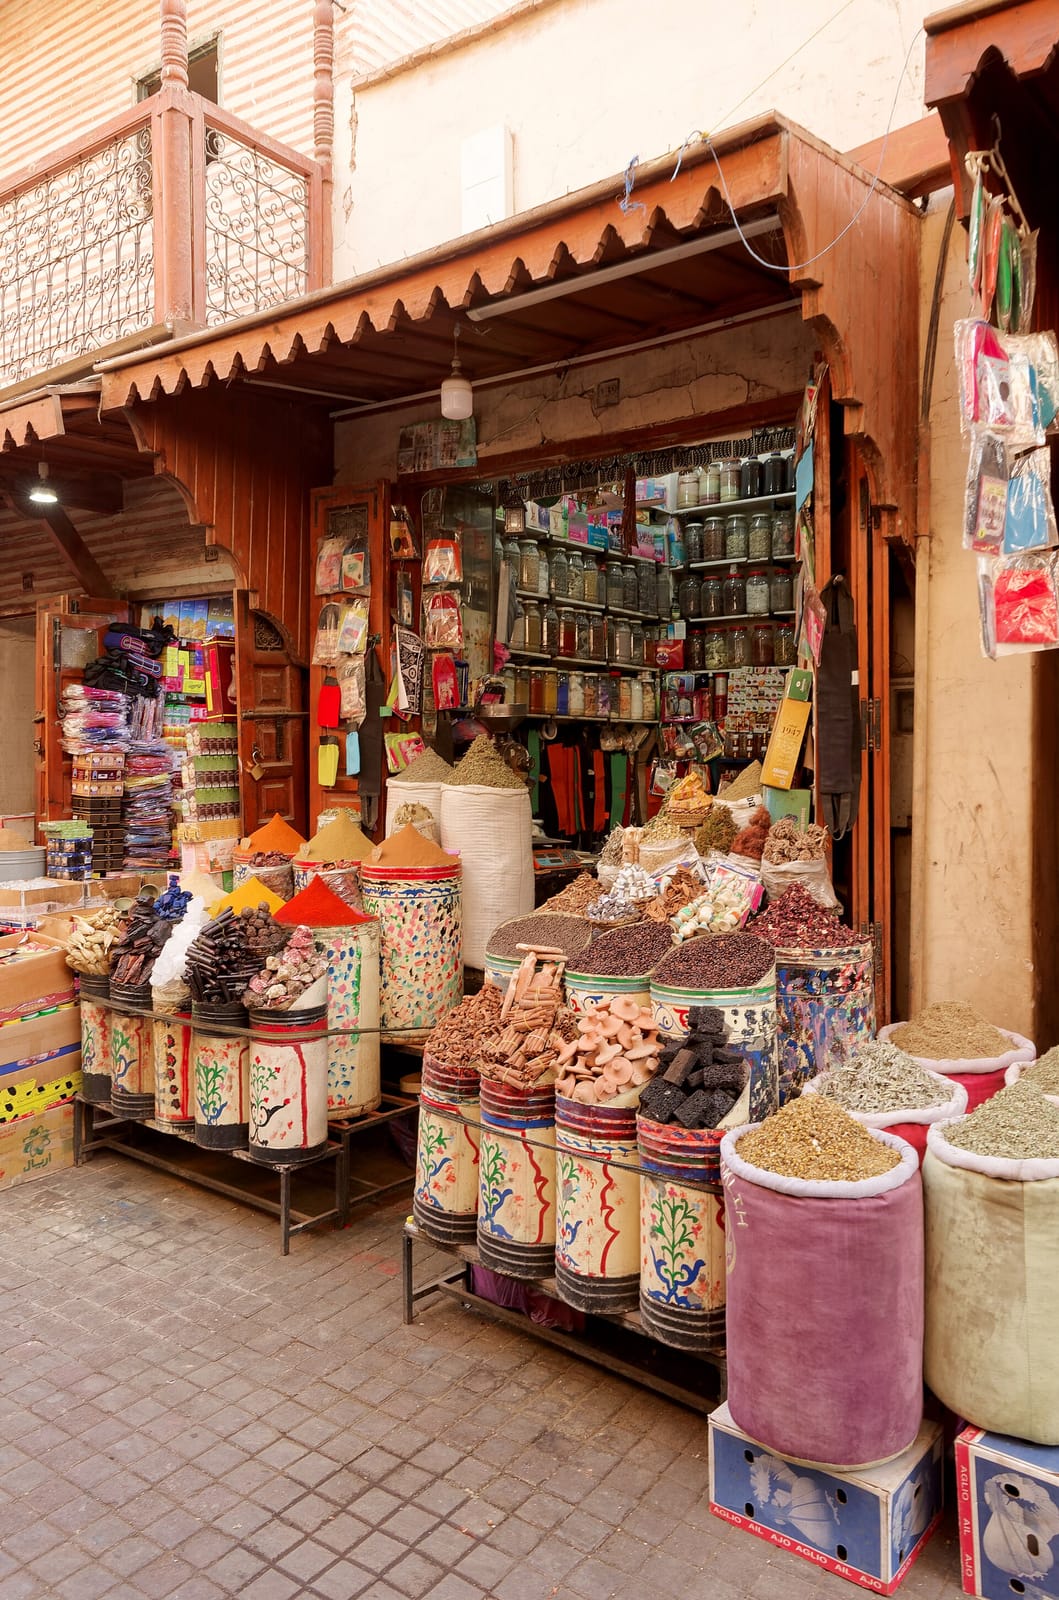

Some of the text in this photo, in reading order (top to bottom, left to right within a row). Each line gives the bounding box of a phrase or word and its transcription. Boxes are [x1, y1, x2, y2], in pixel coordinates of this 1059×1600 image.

[961, 1464, 969, 1501] AGLIO
[713, 1506, 882, 1589] AGLIO AIL AJO AGLIO AIL AJO
[964, 1553, 973, 1577] AJO
